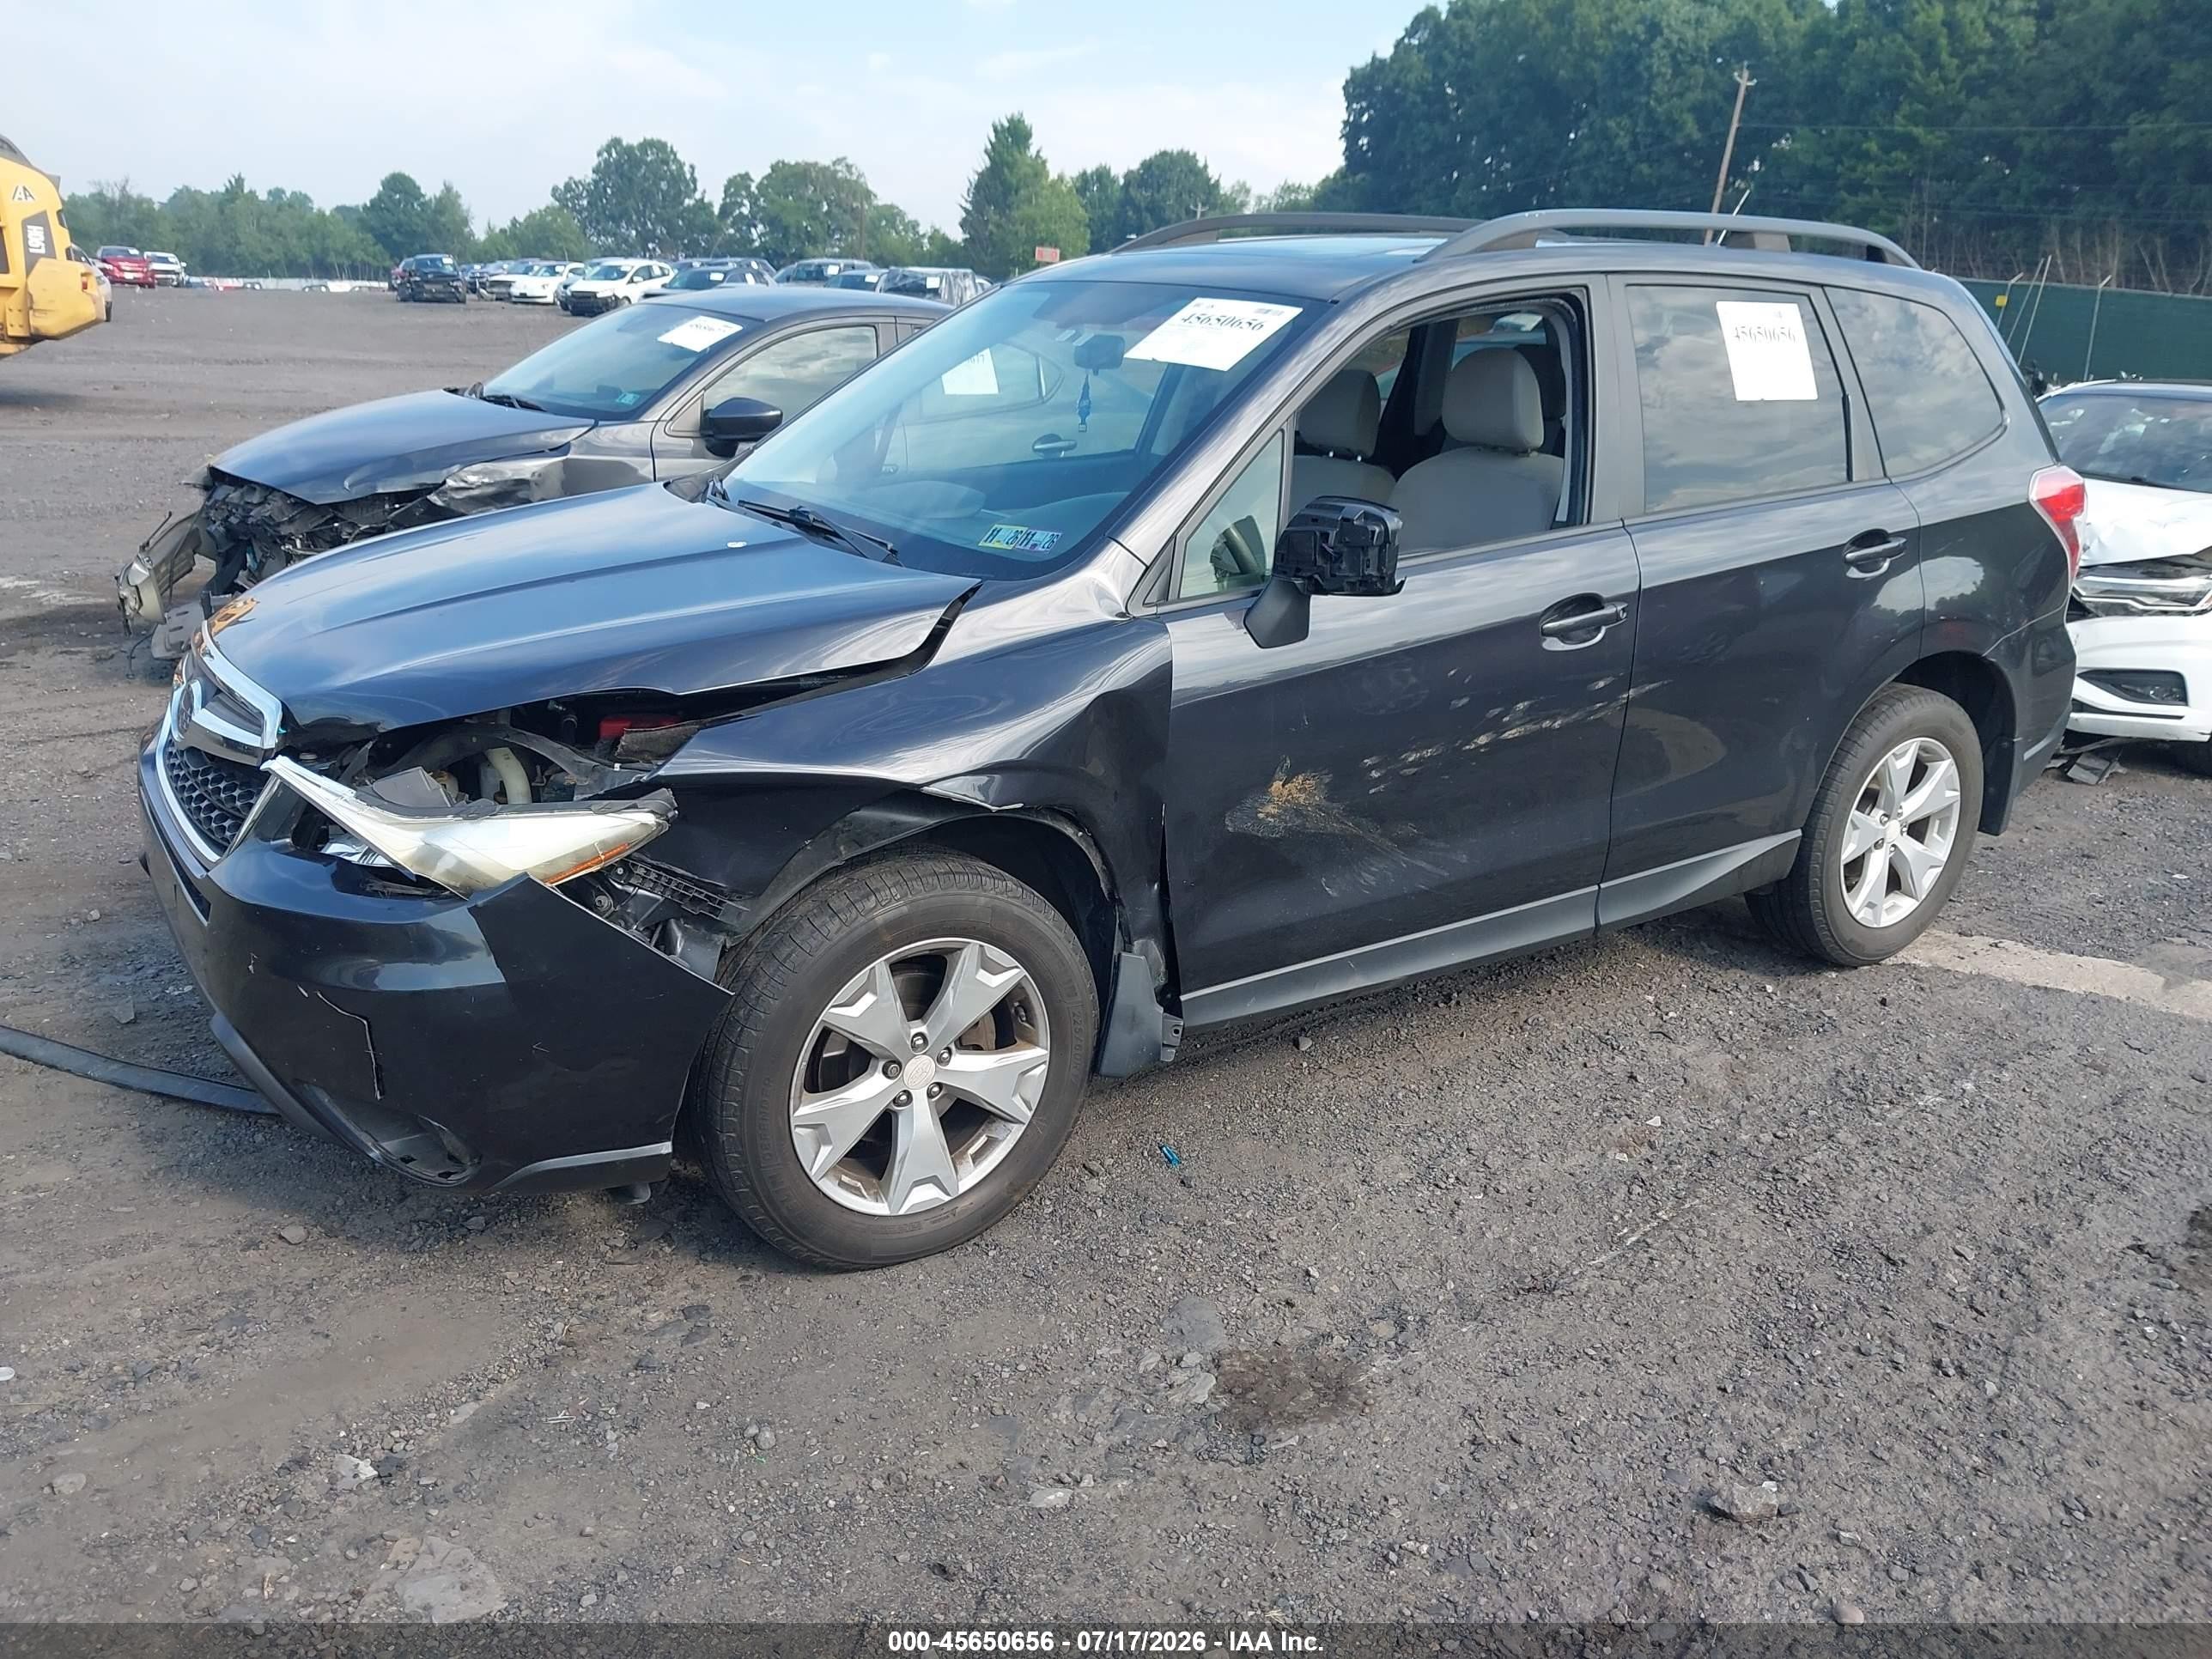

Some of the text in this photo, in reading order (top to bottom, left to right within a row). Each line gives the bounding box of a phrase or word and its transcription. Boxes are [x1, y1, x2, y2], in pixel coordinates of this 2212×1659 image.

[27, 225, 46, 254] L90H
[1182, 313, 1265, 331] 45650656
[1735, 325, 1796, 343] 45650656
